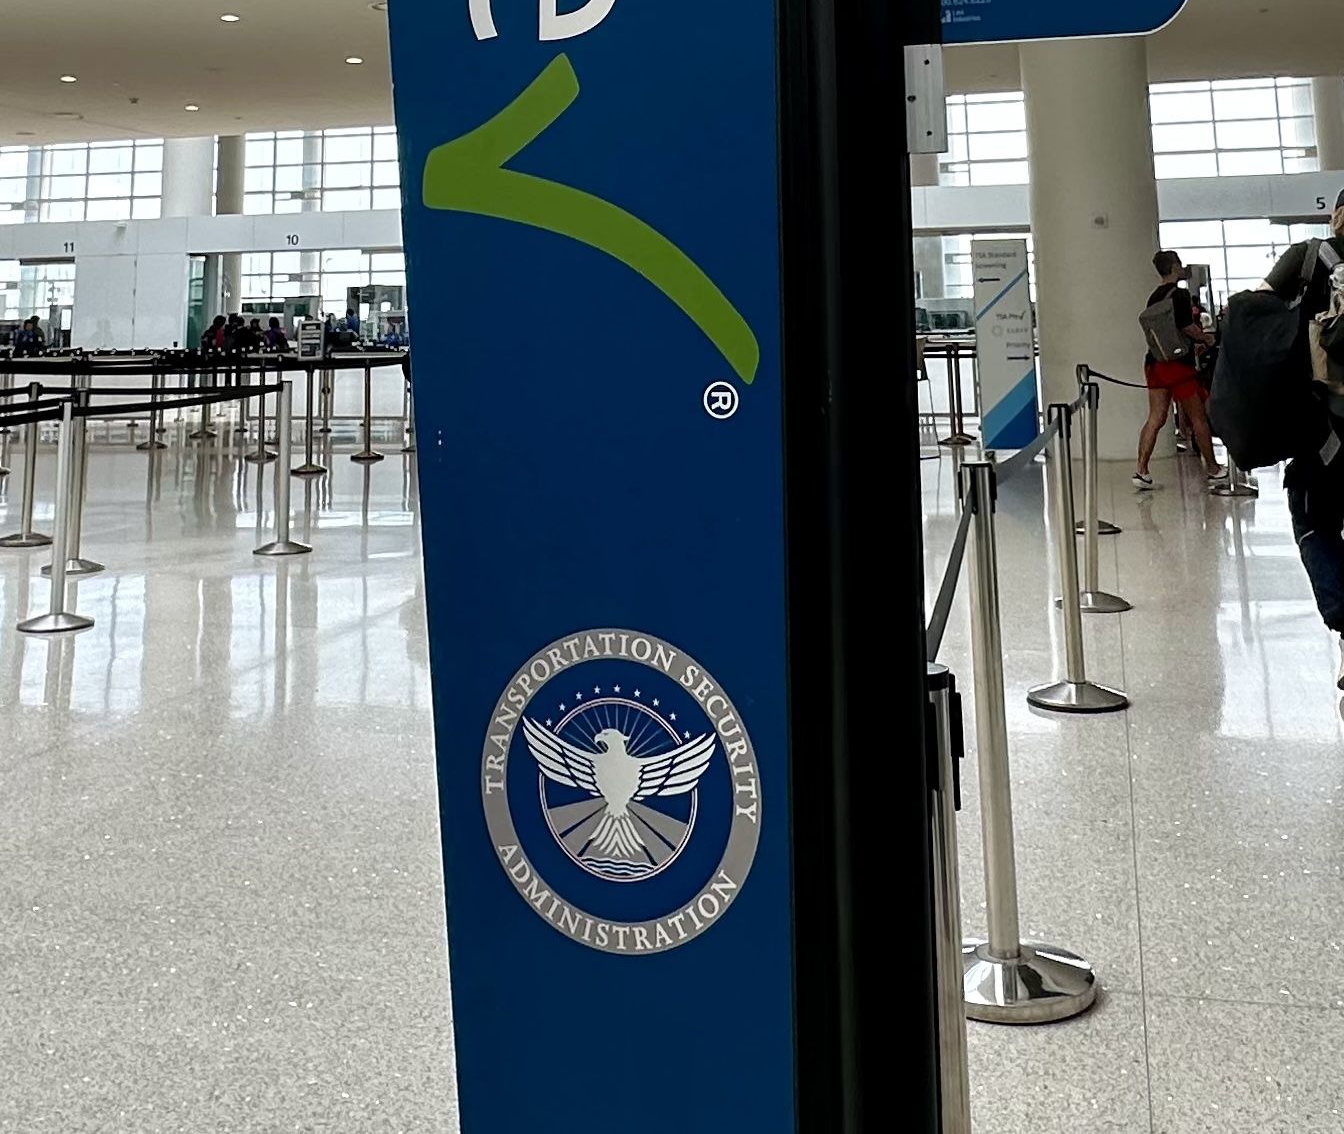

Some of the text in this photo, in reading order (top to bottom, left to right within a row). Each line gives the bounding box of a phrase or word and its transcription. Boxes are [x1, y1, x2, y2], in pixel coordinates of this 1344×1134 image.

[1316, 197, 1326, 210] 5
[286, 234, 299, 246] 10
[63, 241, 74, 253] 11
[485, 632, 757, 824] TRANSPORTATION SECURITY
[498, 843, 738, 951] ADMINISTRATION
